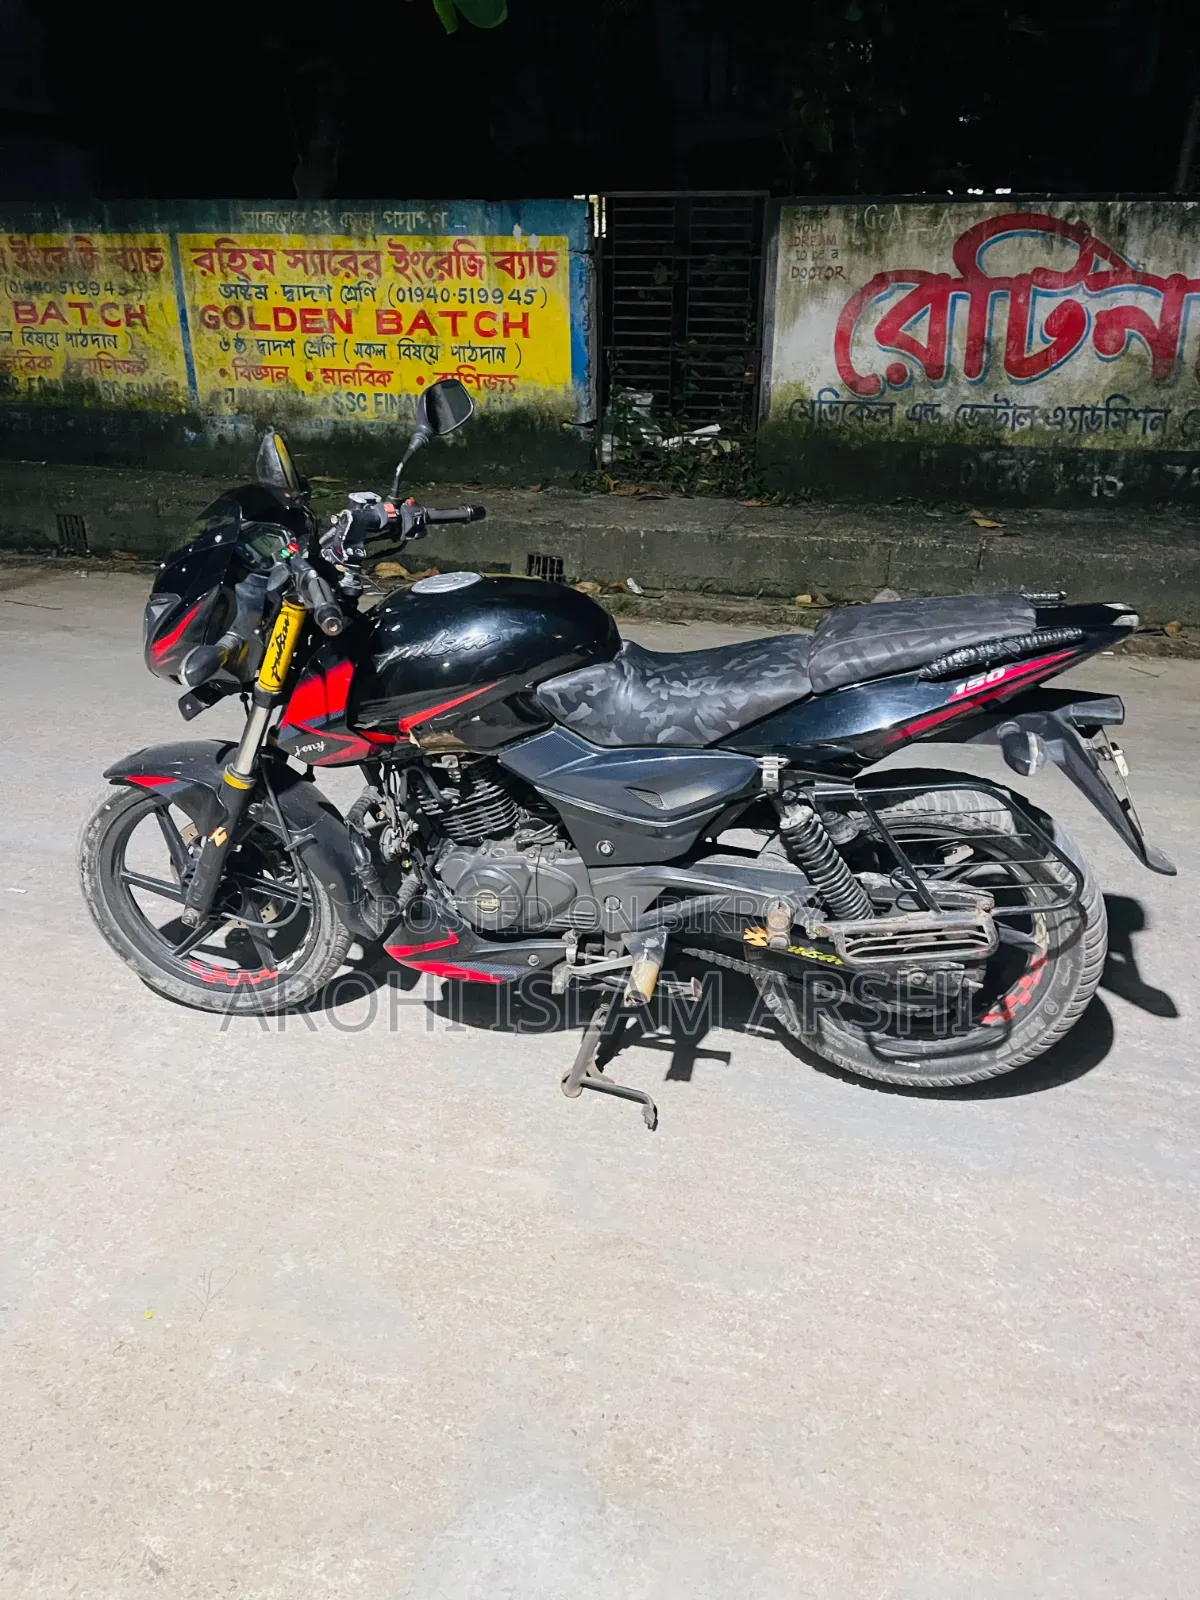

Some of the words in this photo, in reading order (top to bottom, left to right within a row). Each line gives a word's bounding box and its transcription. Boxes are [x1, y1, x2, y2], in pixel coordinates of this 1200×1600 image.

[189, 238, 276, 281] রহিম
[281, 248, 384, 281] স্যারের
[388, 238, 485, 284] ইংরেজি
[490, 250, 560, 281] ব্যাচ
[791, 265, 847, 281] DOCTOR
[12, 301, 150, 334] BATCH
[202, 304, 354, 335] GOLDEN
[375, 309, 531, 339] BATCH
[955, 667, 1006, 695] 150
